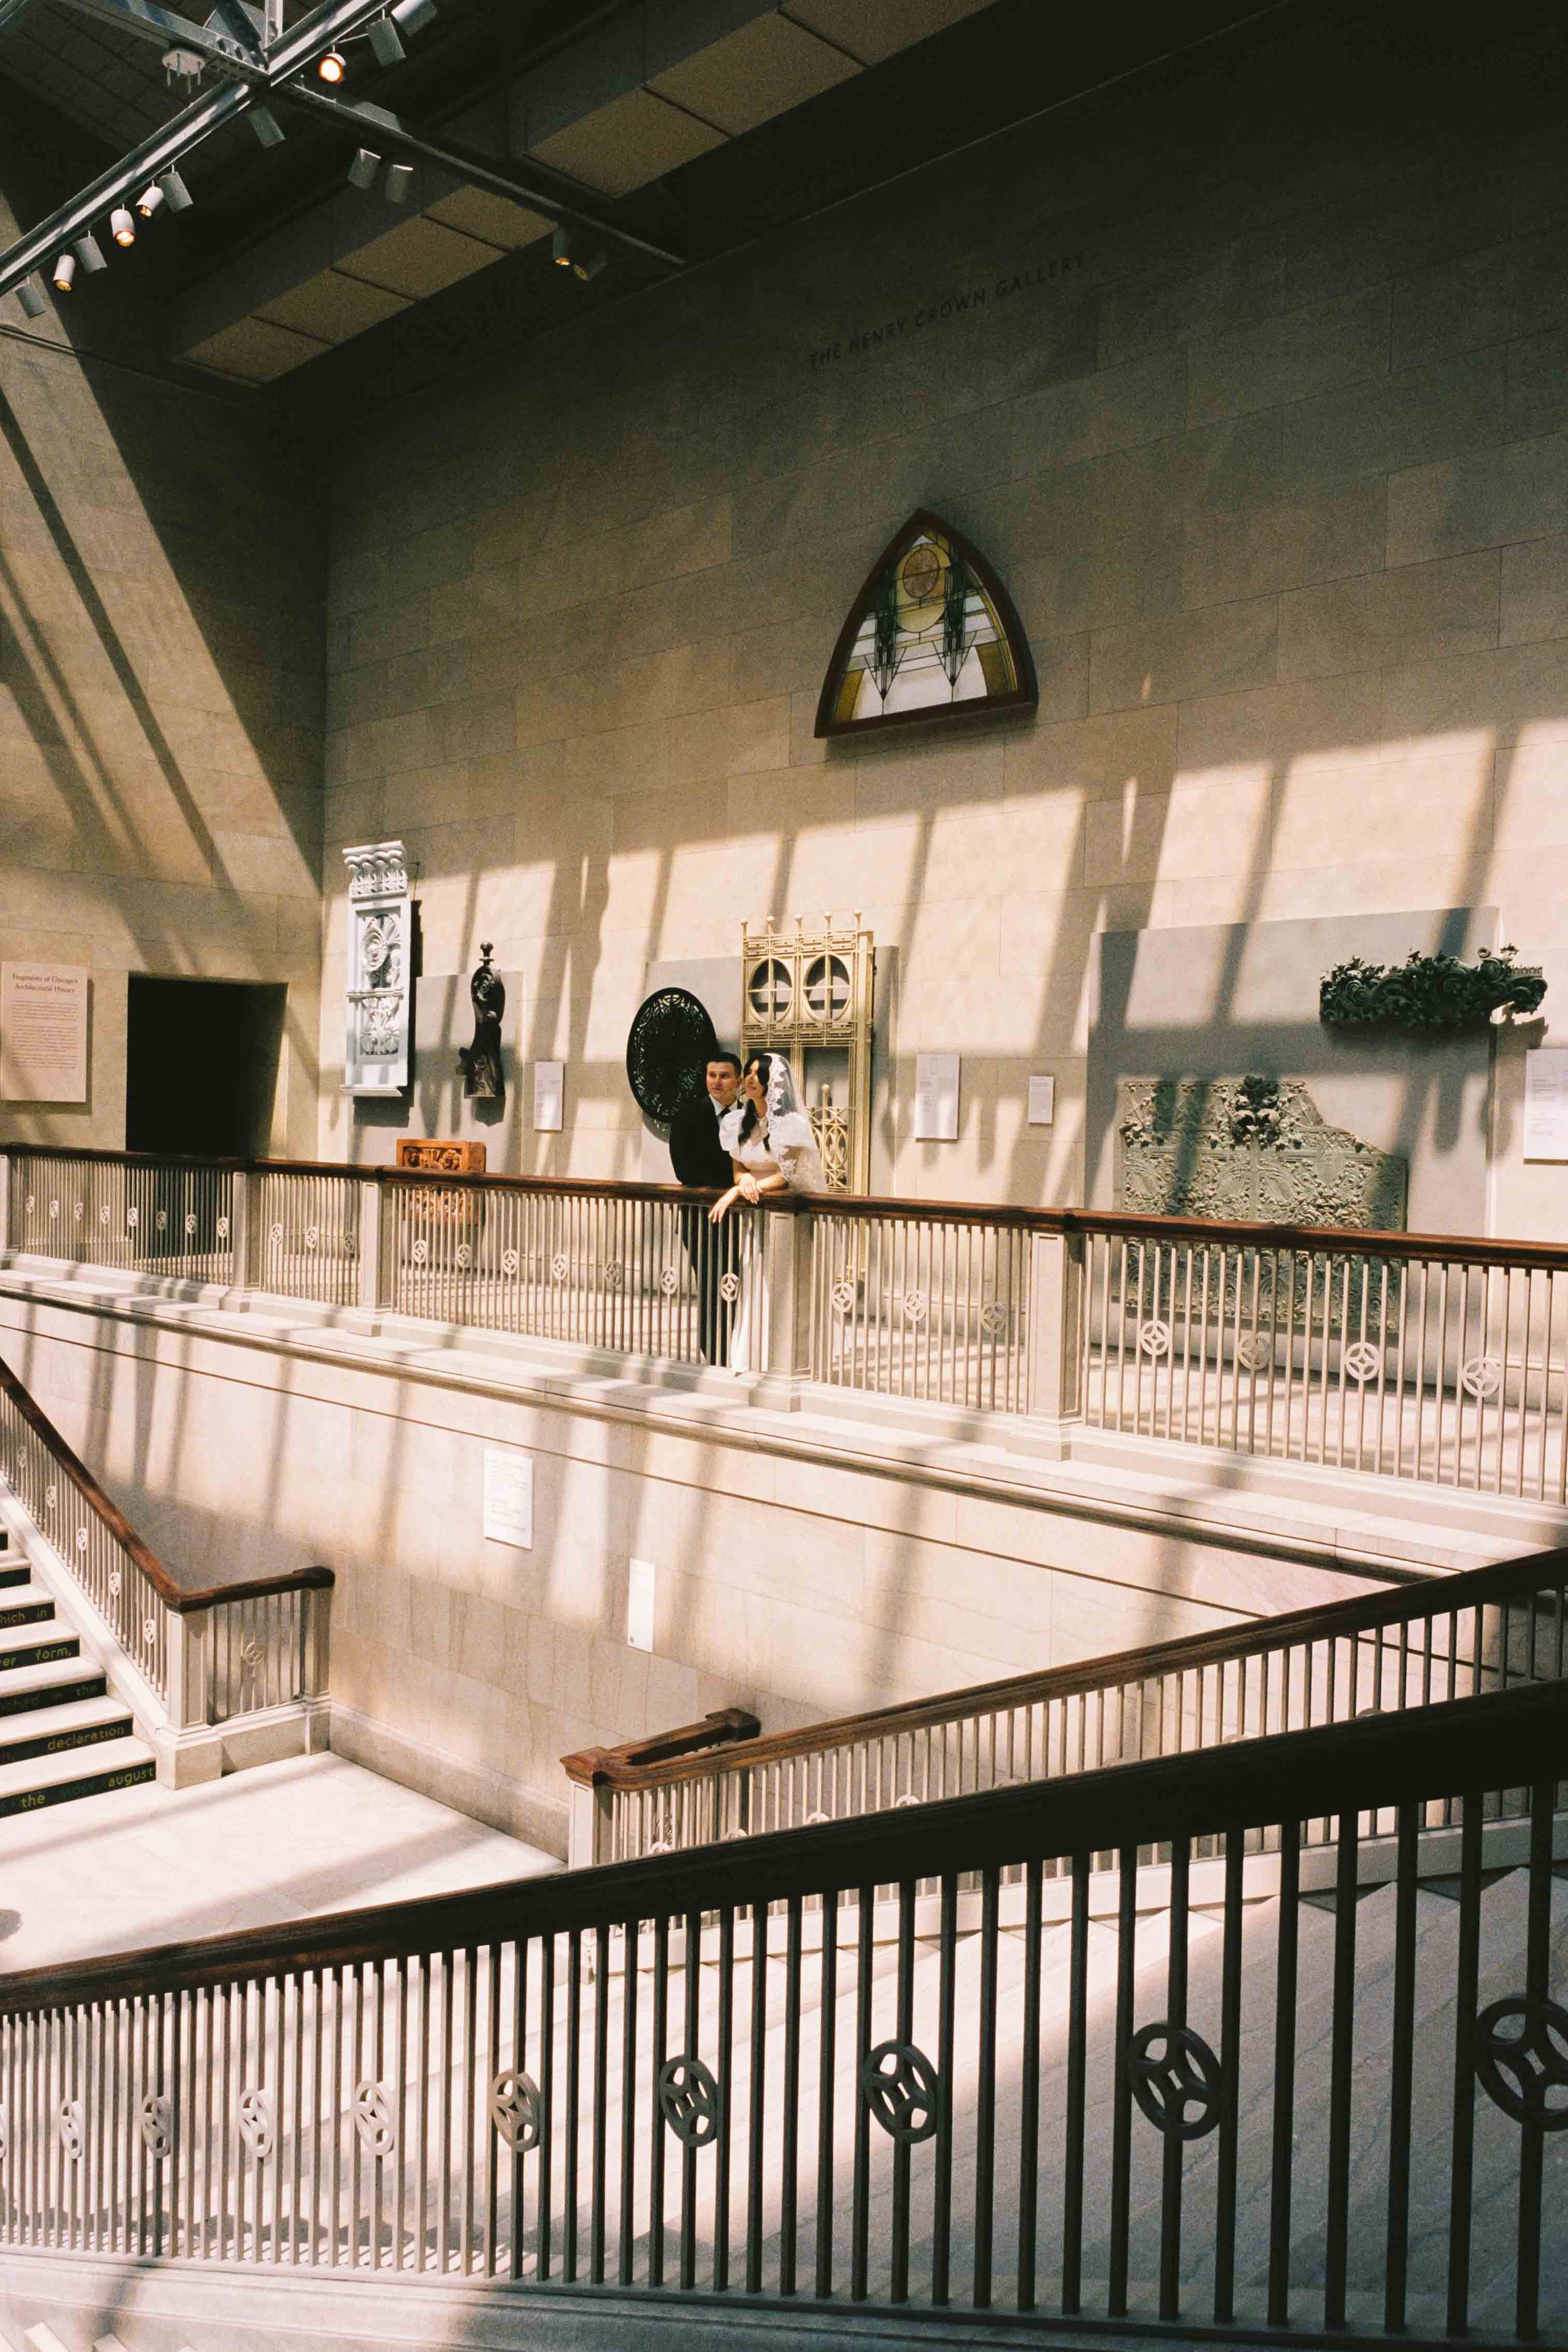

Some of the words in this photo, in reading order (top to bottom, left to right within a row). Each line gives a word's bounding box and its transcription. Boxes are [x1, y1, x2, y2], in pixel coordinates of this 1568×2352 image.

[810, 343, 840, 367] THE
[849, 320, 906, 353] HENRY
[915, 288, 985, 327] CROWN
[997, 252, 1084, 298] GALLERY
[37, 1608, 47, 1618] in
[0, 1656, 16, 1666] er
[34, 1647, 72, 1661] form,
[76, 1683, 98, 1697] the
[47, 1726, 124, 1751] declaration
[20, 1792, 45, 1808] the
[108, 1767, 154, 1788] august
